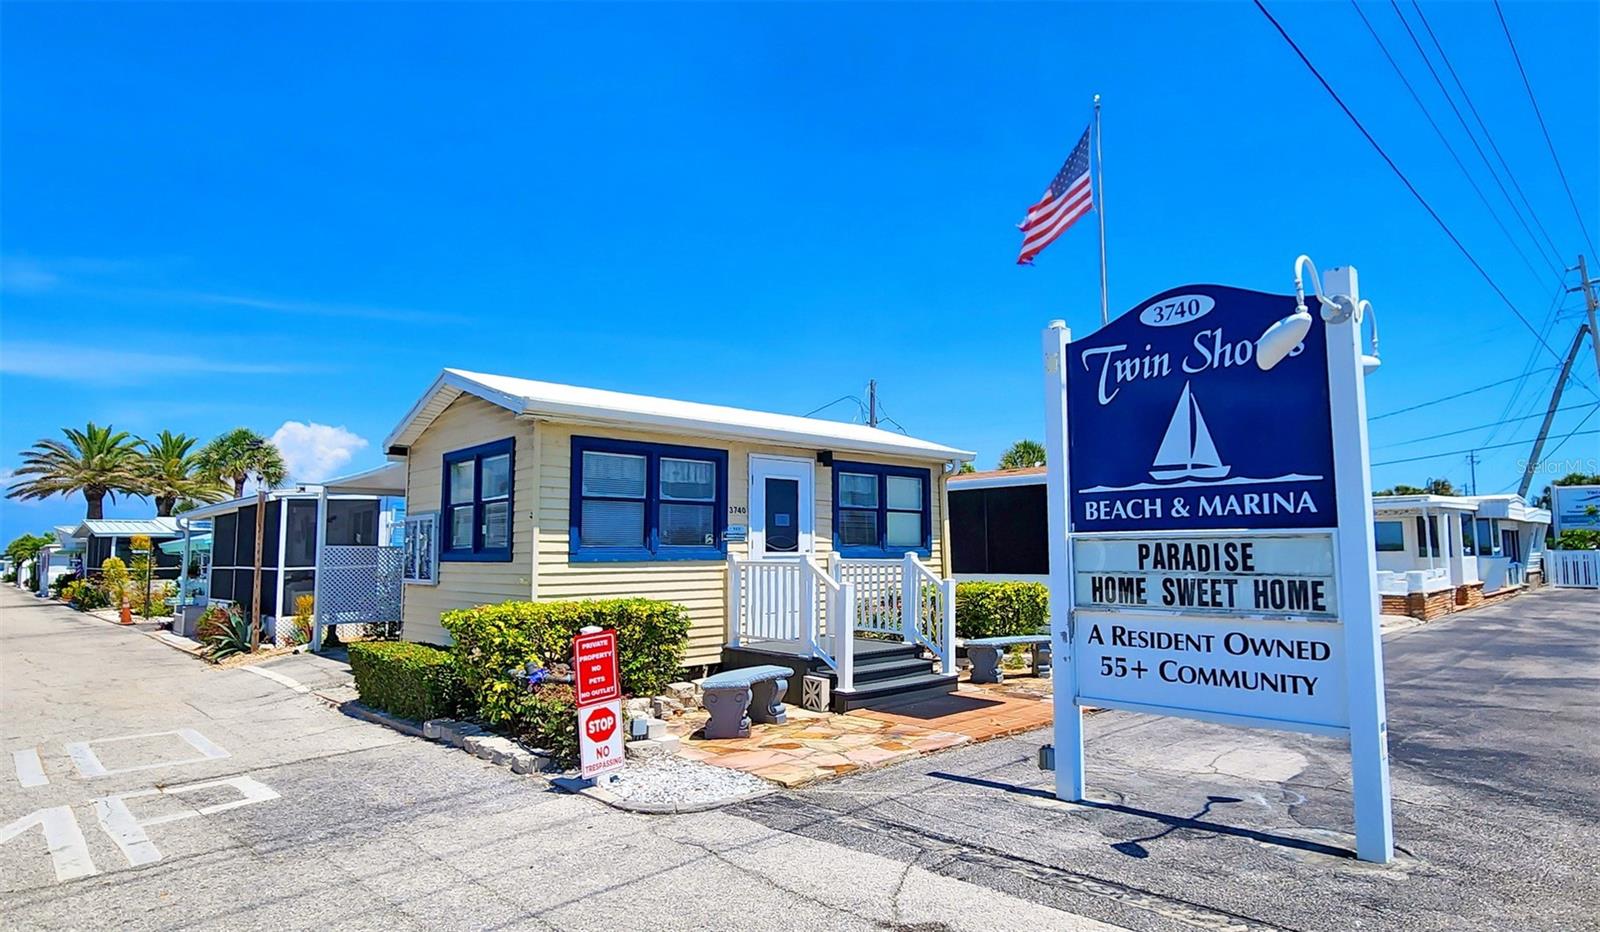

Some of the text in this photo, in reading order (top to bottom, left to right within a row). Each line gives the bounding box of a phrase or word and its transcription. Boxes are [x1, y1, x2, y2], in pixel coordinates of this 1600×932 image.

[1153, 299, 1199, 322] 3740
[1082, 344, 1172, 405] Twin
[1085, 491, 1317, 520] BEACH & MARINA
[1138, 542, 1255, 572] PARADISE
[1092, 577, 1326, 611] HOME SWEET HOME
[582, 640, 608, 649] PRIVATE
[1088, 625, 1330, 661] A RESIDENT OWNED
[580, 651, 613, 662] PROPERTY
[589, 676, 605, 684] PETS
[1101, 656, 1318, 695] 55+ COMMUNITY
[591, 686, 614, 695] OUTLET
[588, 717, 614, 734] STOP
[596, 746, 610, 759] NO
[585, 757, 622, 774] TRESPASSING
